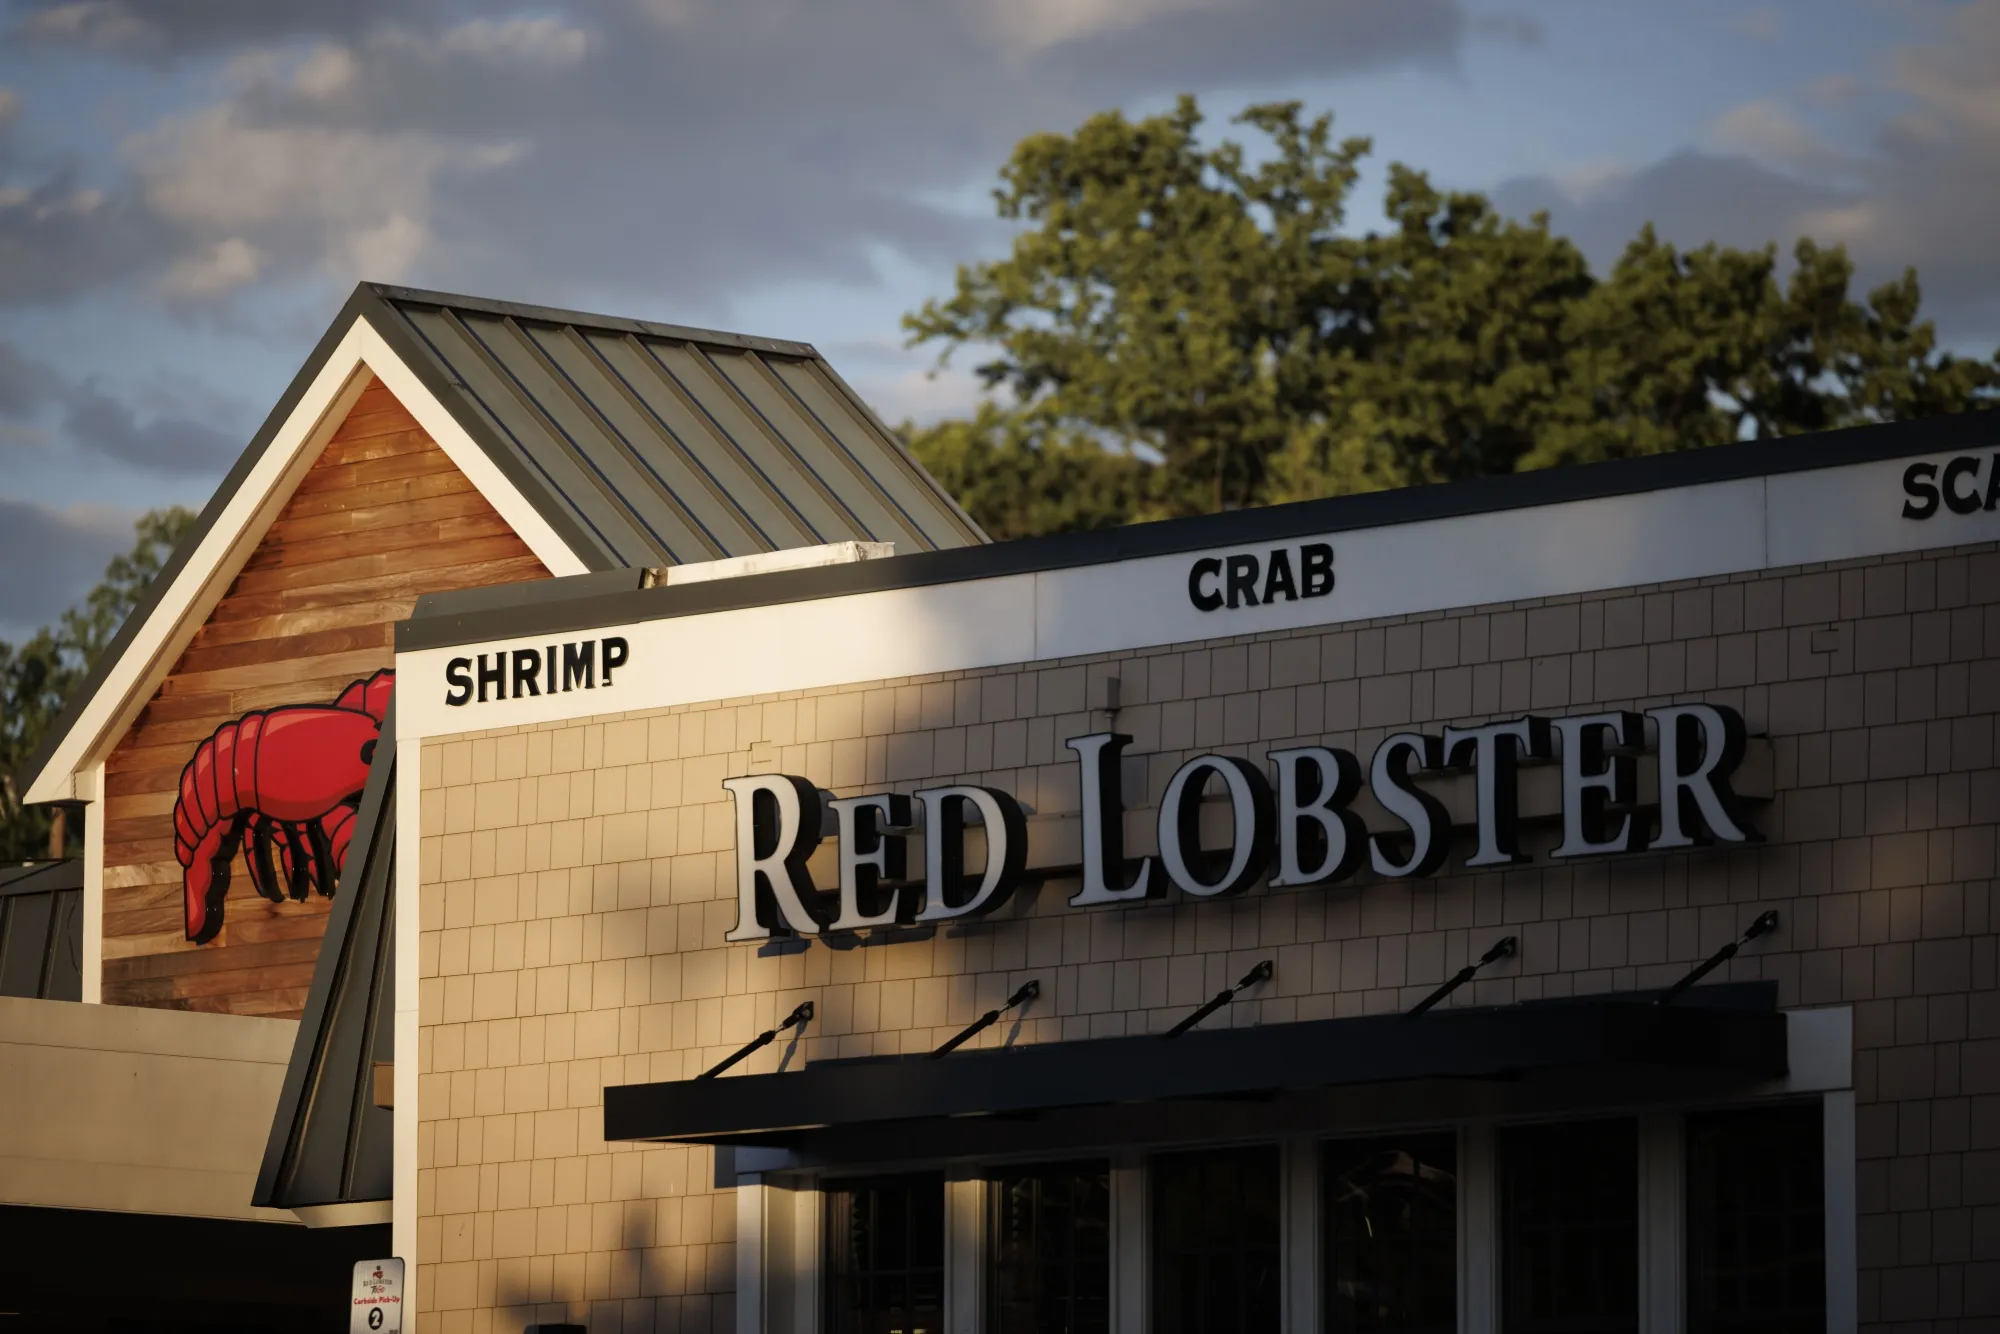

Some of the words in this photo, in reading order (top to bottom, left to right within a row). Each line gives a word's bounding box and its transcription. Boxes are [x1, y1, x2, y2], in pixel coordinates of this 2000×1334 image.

[1188, 542, 1336, 613] CRAB
[445, 636, 630, 707] SHRIMP
[722, 773, 1028, 942] RED
[1065, 702, 1760, 908] LOBSTER
[372, 1310, 380, 1326] 2
